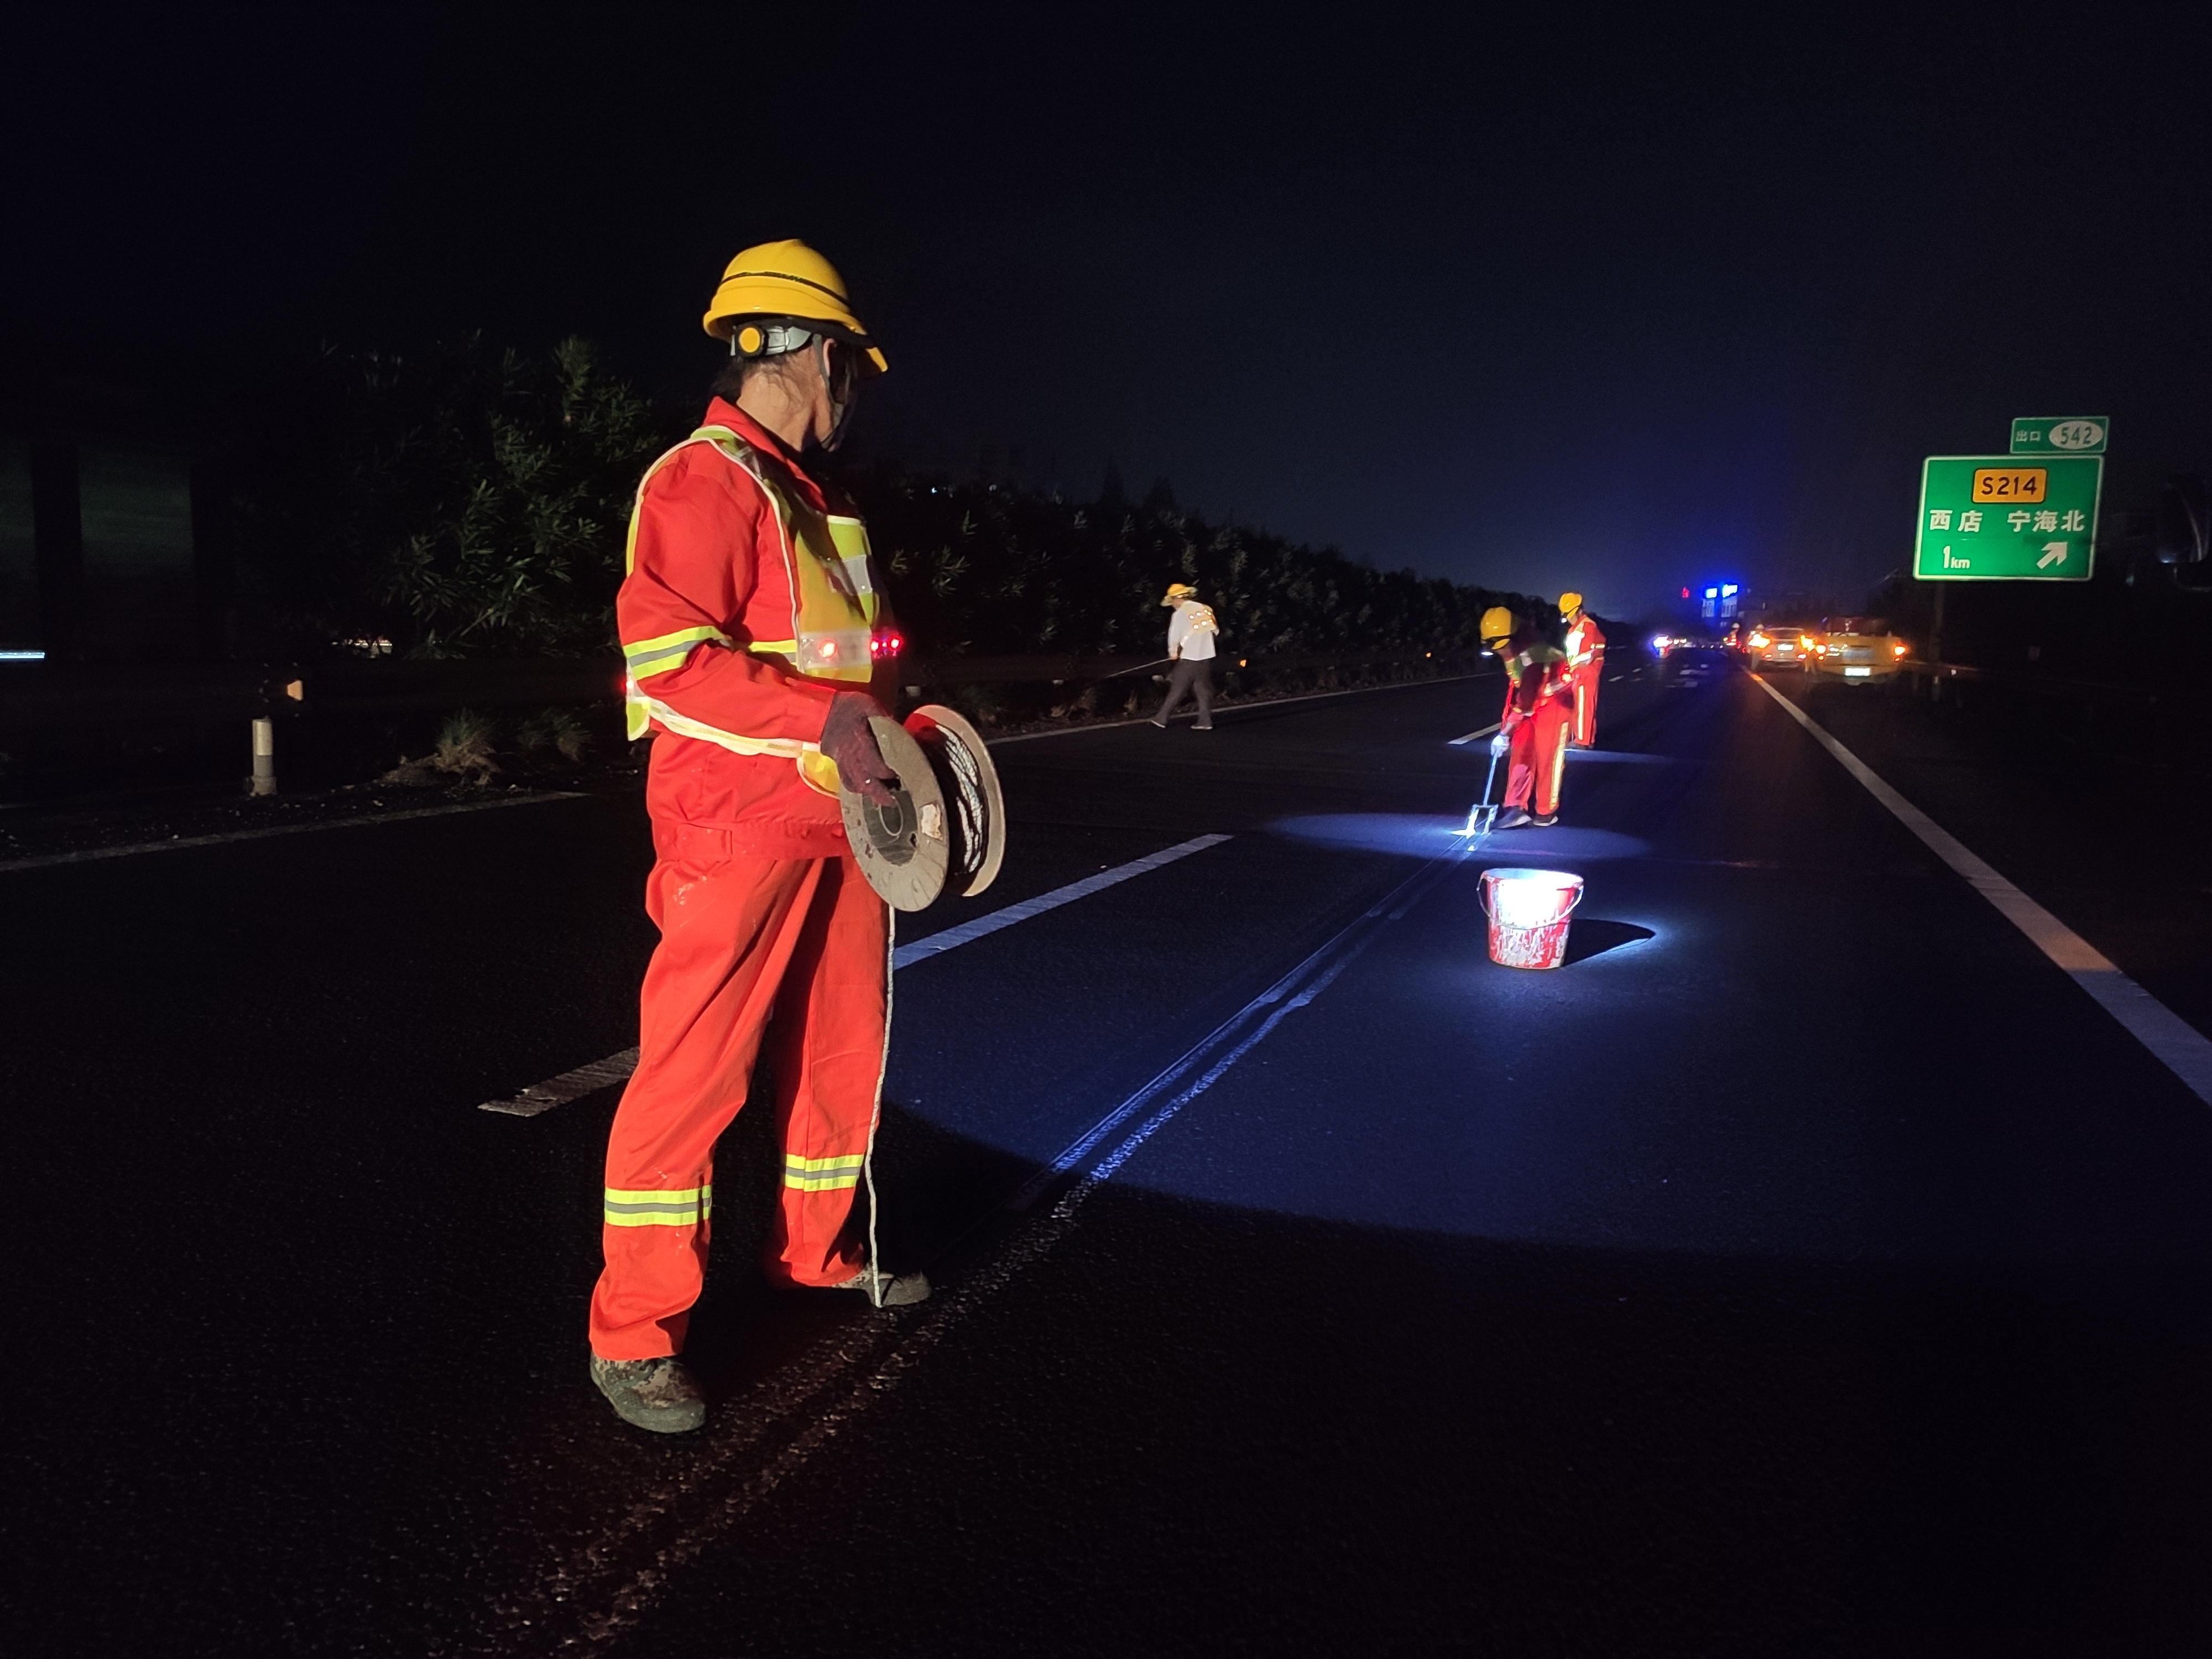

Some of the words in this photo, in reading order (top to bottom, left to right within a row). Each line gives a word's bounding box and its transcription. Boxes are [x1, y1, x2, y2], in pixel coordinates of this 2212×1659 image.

[2016, 430, 2041, 442] 出口
[2059, 426, 2092, 445] 542
[1981, 476, 2037, 495] S214
[1929, 510, 1983, 533] 西店
[2007, 510, 2085, 533] 宁海北
[1943, 545, 1970, 569] 1km
